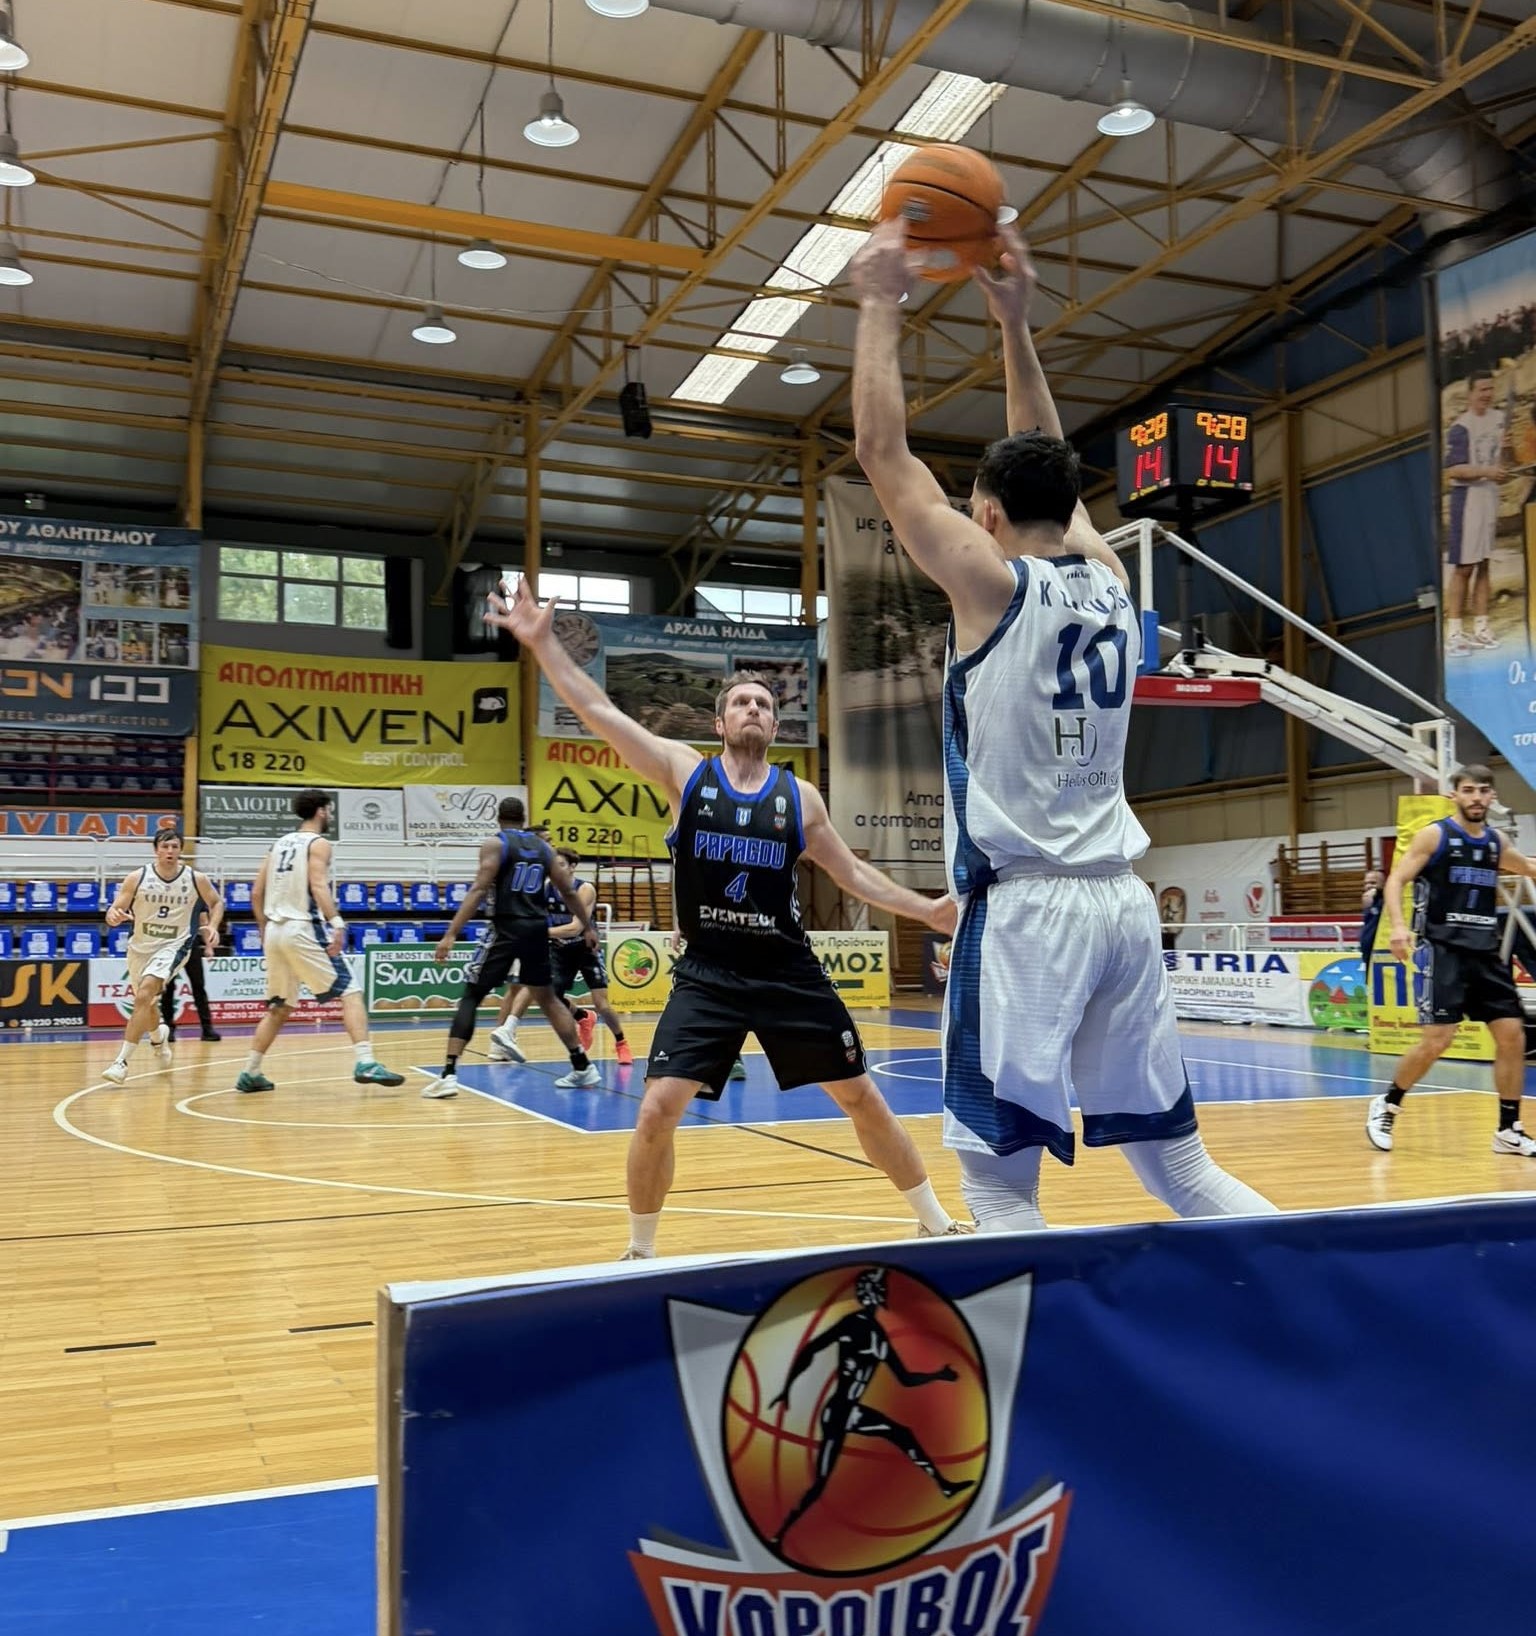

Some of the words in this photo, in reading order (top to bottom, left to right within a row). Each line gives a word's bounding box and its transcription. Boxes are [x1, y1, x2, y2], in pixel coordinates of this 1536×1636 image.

[1130, 412, 1168, 447] 9:28
[1196, 412, 1248, 441] 9:28
[1136, 446, 1162, 489] 14
[1204, 443, 1239, 481] 14
[26, 523, 157, 545] ΑΘΛΗΤΙΣΜΟΥ
[664, 622, 718, 637] ΑΡΧΑΙΑ
[722, 626, 768, 641] ΗΛΙΔΑ
[218, 661, 424, 695] ΑΠΟΛΥΜΑΝΤΙΚΗ
[1052, 623, 1127, 710] 10
[45, 712, 170, 726] CONSTRUCTION
[213, 698, 465, 746] AXIVEN
[229, 752, 256, 770] 18
[263, 753, 306, 772] 220
[557, 826, 578, 843] 18
[587, 827, 623, 844] 220
[855, 815, 866, 827] a
[694, 830, 787, 869] PAPAGOU
[909, 837, 942, 851] and
[511, 861, 545, 893] 10
[725, 871, 750, 903] 4
[157, 905, 170, 918] 9
[376, 952, 393, 960] THE
[396, 952, 421, 960] MOST
